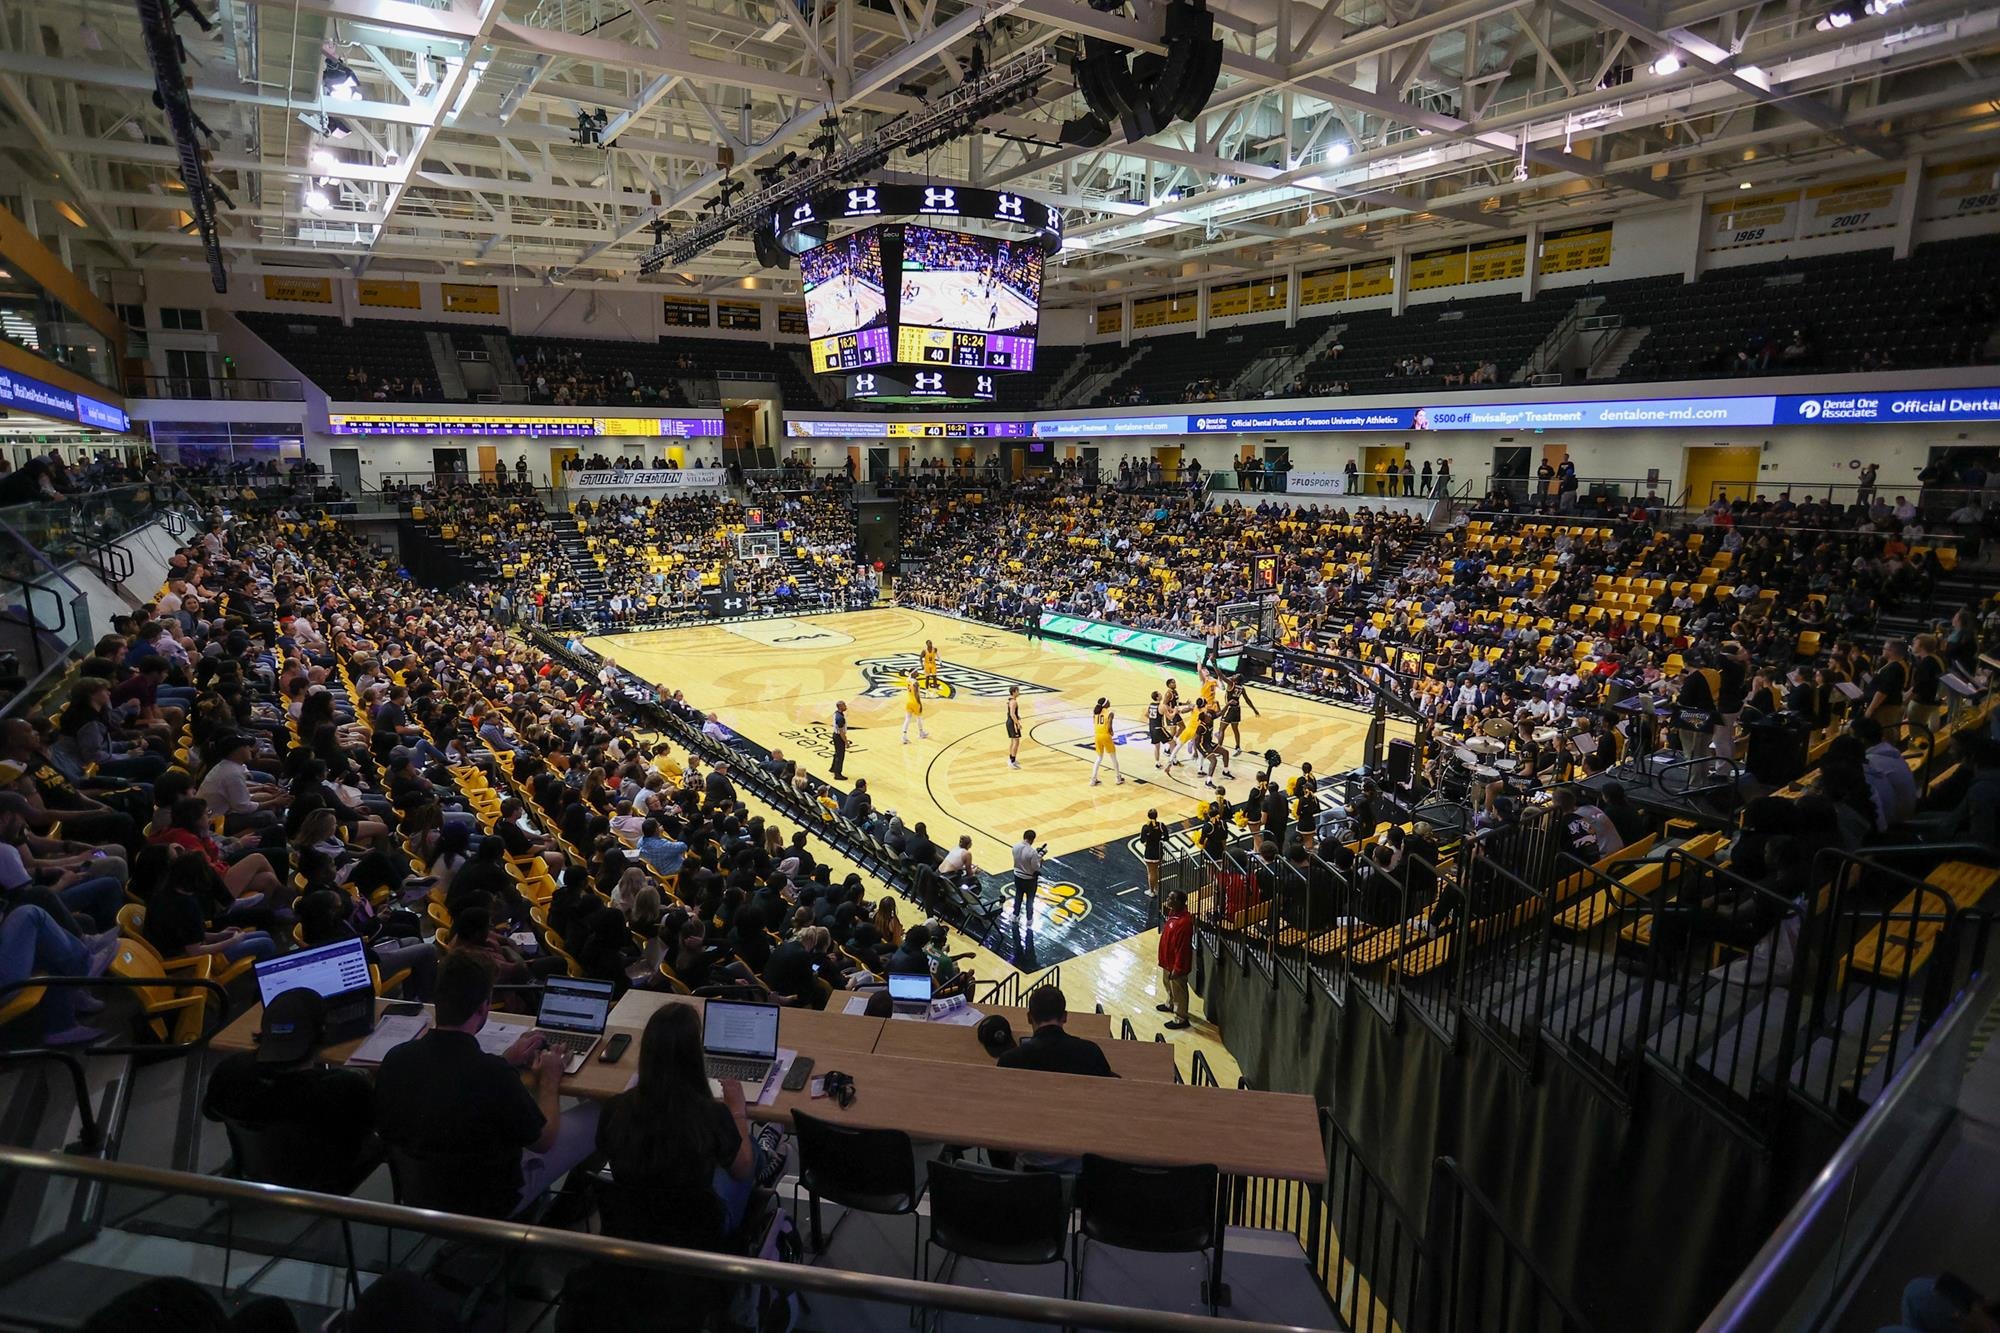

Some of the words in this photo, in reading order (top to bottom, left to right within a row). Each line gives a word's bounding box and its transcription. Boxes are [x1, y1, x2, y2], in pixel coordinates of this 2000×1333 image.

[1831, 212, 1871, 228] 2007
[1734, 228, 1765, 242] 1969
[840, 336, 857, 349] 16:24
[956, 334, 984, 347] 16:24
[863, 350, 872, 361] 34
[931, 349, 944, 361] 40
[992, 354, 1005, 365] 34
[829, 356, 837, 367] 40
[1823, 399, 1853, 410] Dental
[1857, 398, 1879, 409] One
[1891, 397, 1946, 413] Official
[1434, 413, 1455, 424] $500
[1457, 412, 1471, 423] off
[1599, 405, 1728, 421] dentalone-md.com
[1822, 408, 1877, 418] Associates
[1232, 419, 1251, 427] Official
[1252, 418, 1272, 427] Dental
[1272, 418, 1296, 426] Practice
[1297, 417, 1305, 426] of
[1305, 417, 1330, 426] Towson
[1331, 416, 1365, 427] University
[1366, 415, 1398, 425] Athletics
[928, 427, 940, 436] 40
[973, 427, 984, 435] 34
[579, 472, 634, 485] STUDENT
[634, 472, 682, 484] SECTION
[1296, 478, 1340, 488] FLOSPORTS
[1096, 714, 1105, 725] 10
[1149, 708, 1158, 719] 25
